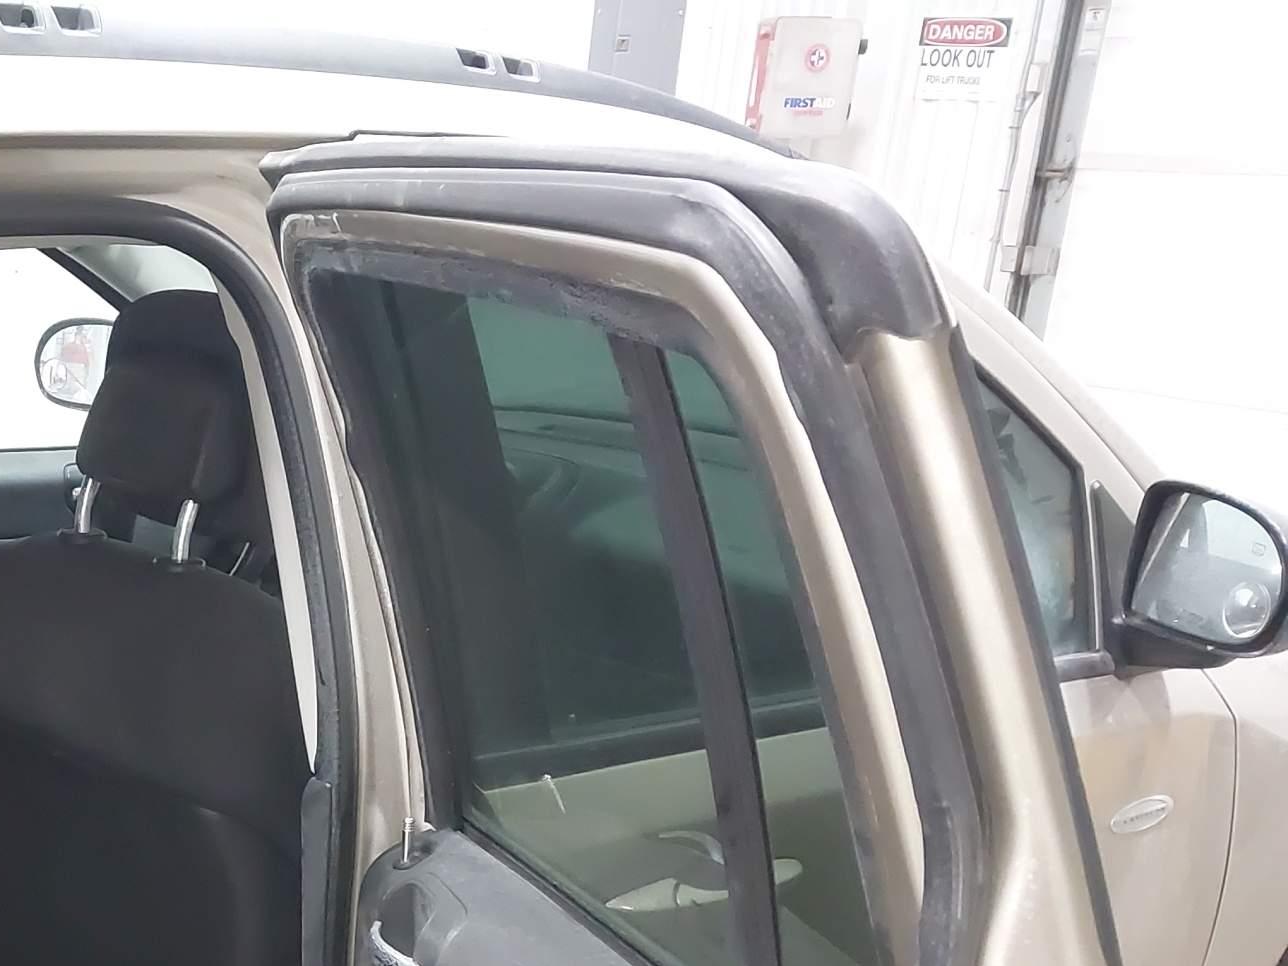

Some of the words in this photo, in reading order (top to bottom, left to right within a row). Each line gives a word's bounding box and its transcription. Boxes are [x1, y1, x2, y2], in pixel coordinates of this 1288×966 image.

[928, 24, 995, 41] DANGER
[920, 48, 963, 68] LOOK
[966, 49, 996, 68] OUT
